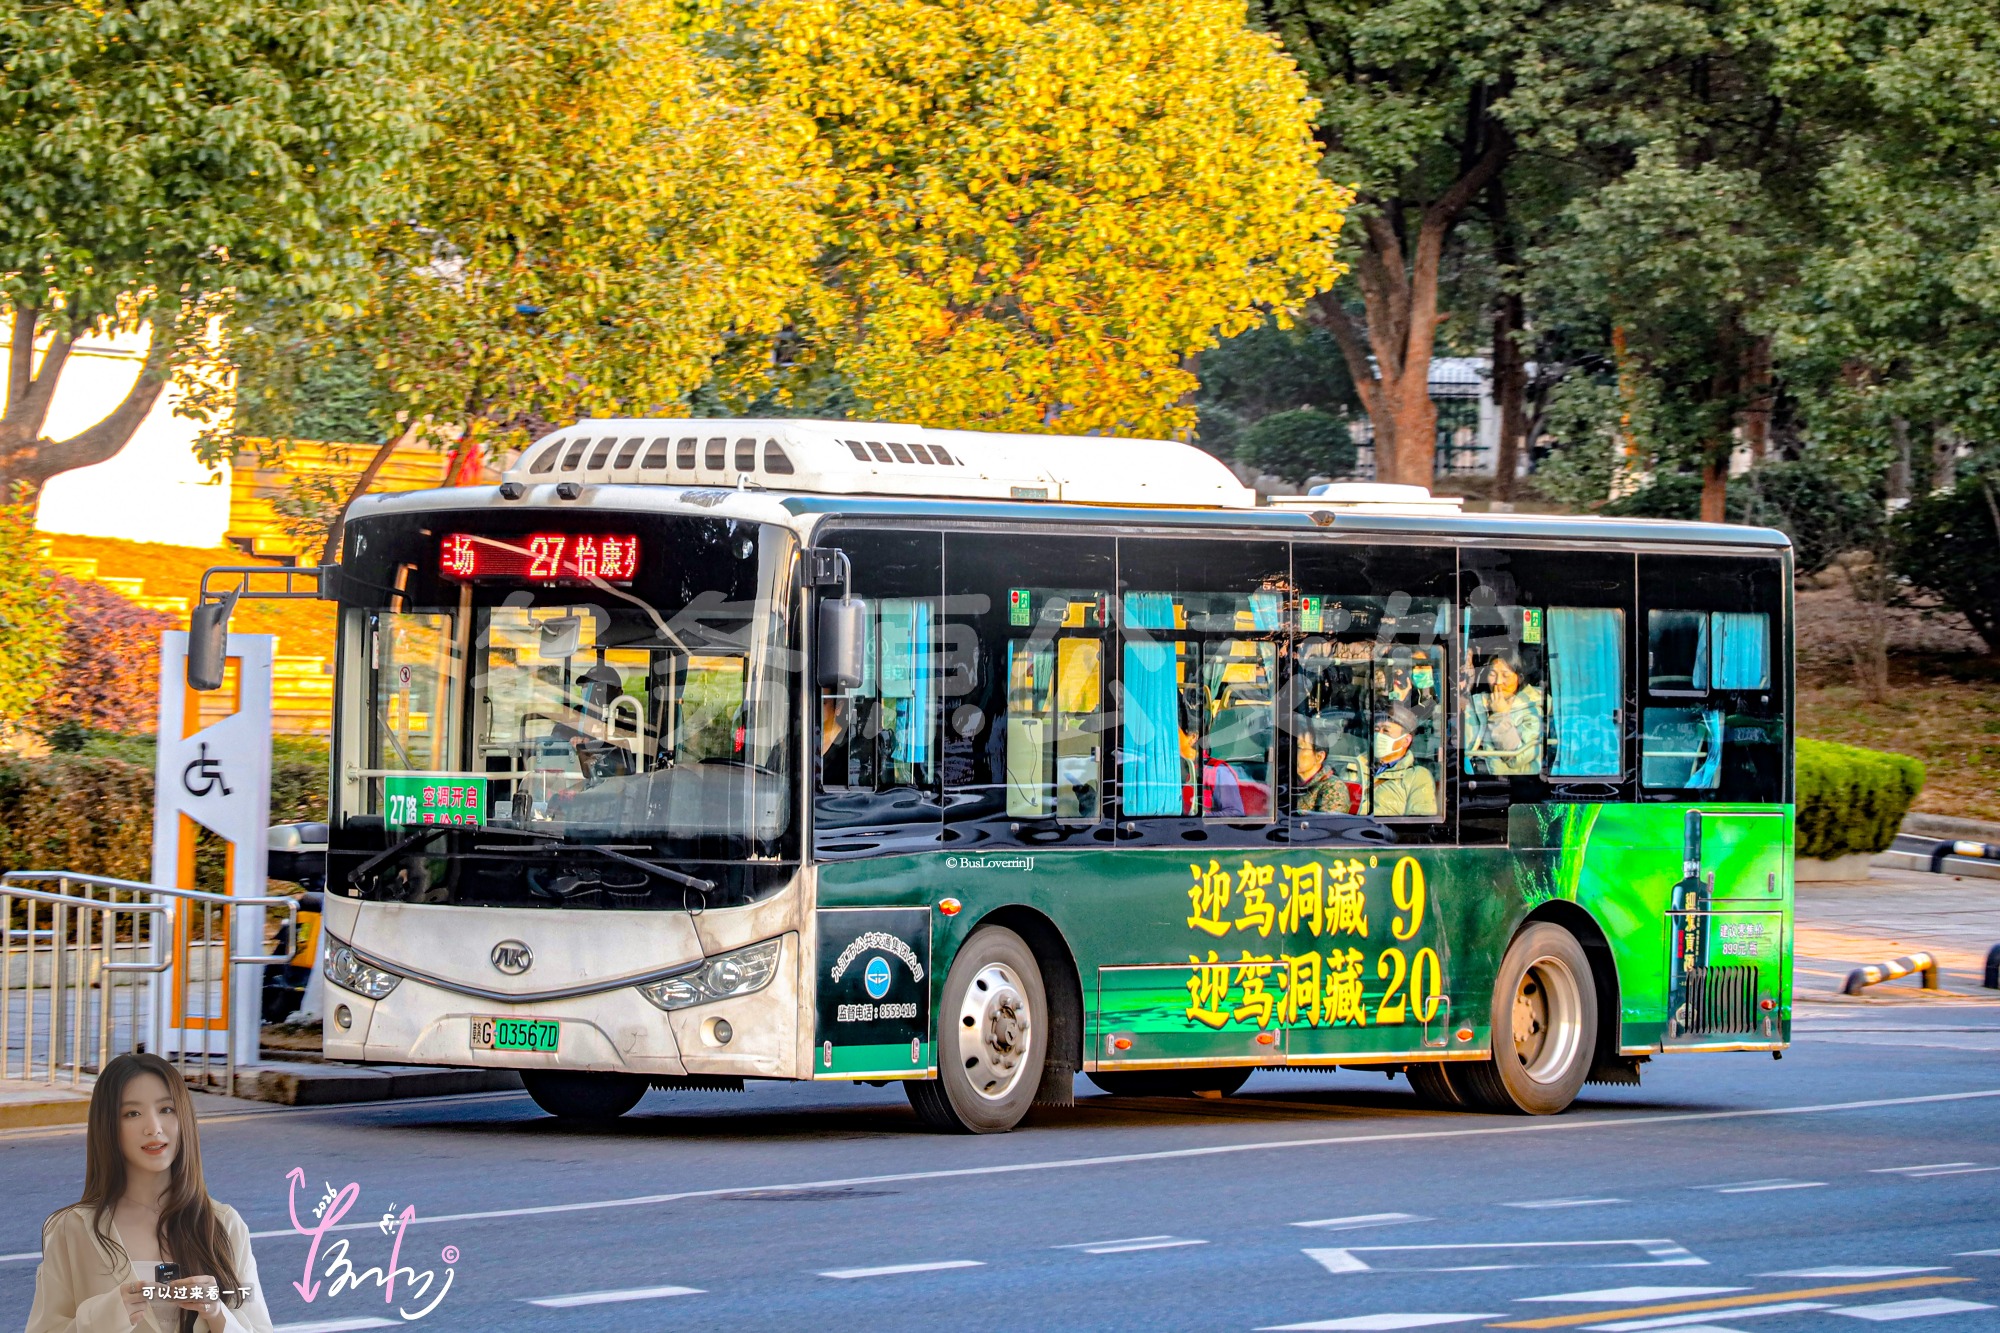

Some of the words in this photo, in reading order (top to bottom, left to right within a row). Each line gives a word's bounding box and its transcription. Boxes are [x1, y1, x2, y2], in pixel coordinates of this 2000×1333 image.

[529, 537, 565, 576] 27
[422, 785, 478, 808] 空调开启
[1391, 856, 1426, 940] 9
[831, 932, 925, 983] 九江市公共交通集团公司
[1186, 947, 1367, 1028] 迎驾洞藏
[1376, 947, 1442, 1024] 20
